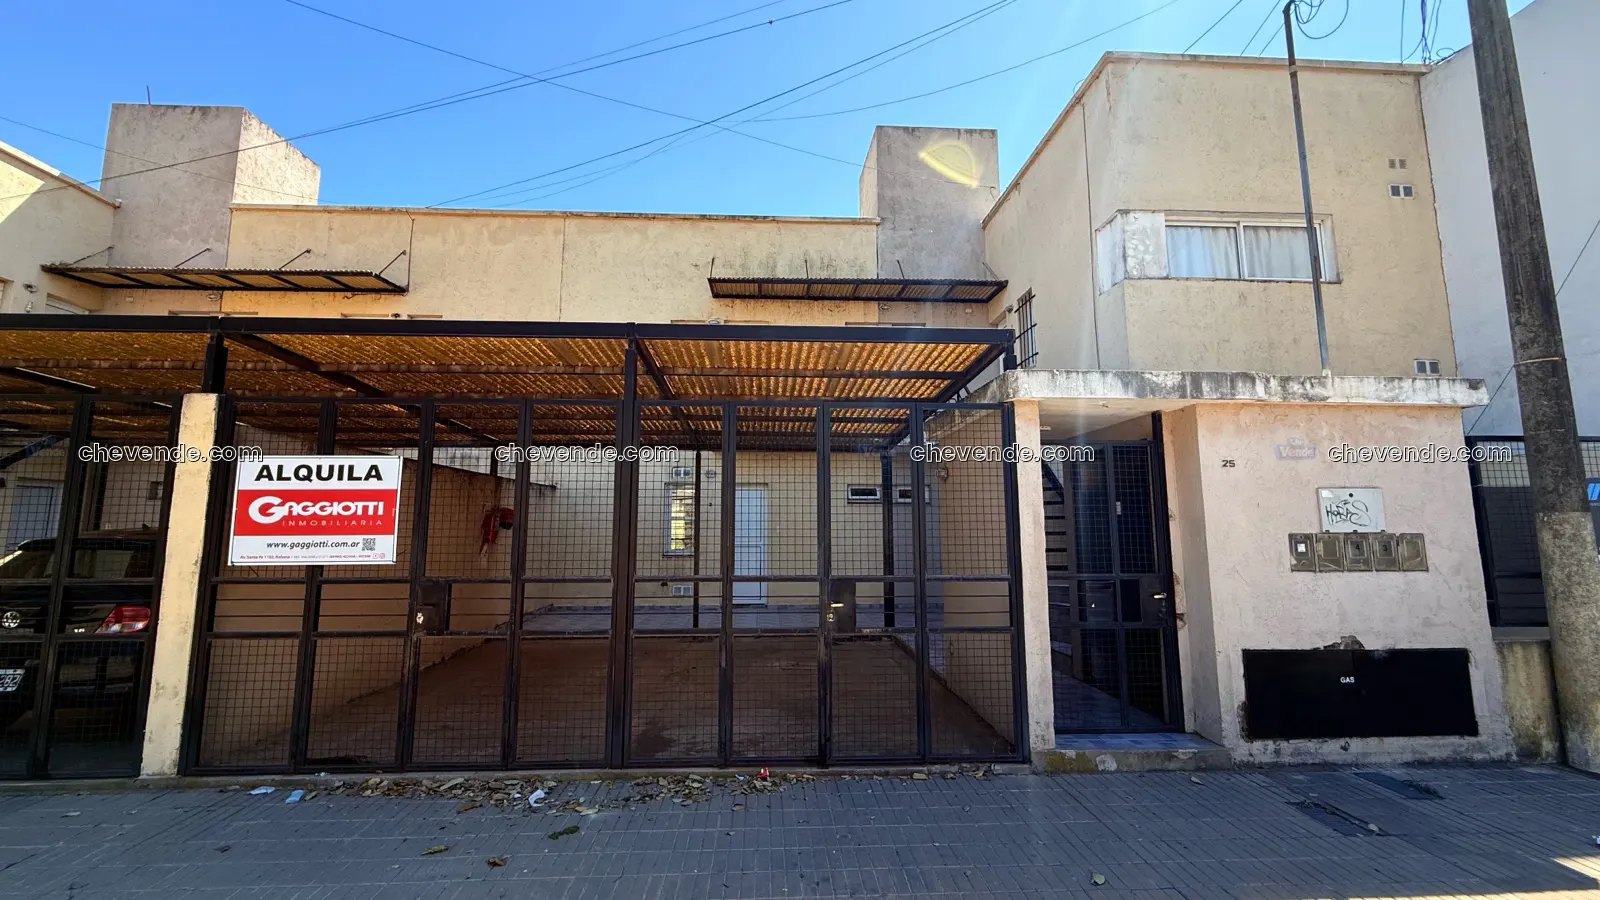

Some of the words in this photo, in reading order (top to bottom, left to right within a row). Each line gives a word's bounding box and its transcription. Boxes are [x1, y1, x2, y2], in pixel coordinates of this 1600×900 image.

[1222, 459, 1236, 468] 25
[254, 464, 383, 483] ALQUILA
[248, 496, 384, 524] GAGGIOTTI
[266, 540, 360, 550] www.gaggiotti.com.ar
[1340, 676, 1355, 684] GAS
